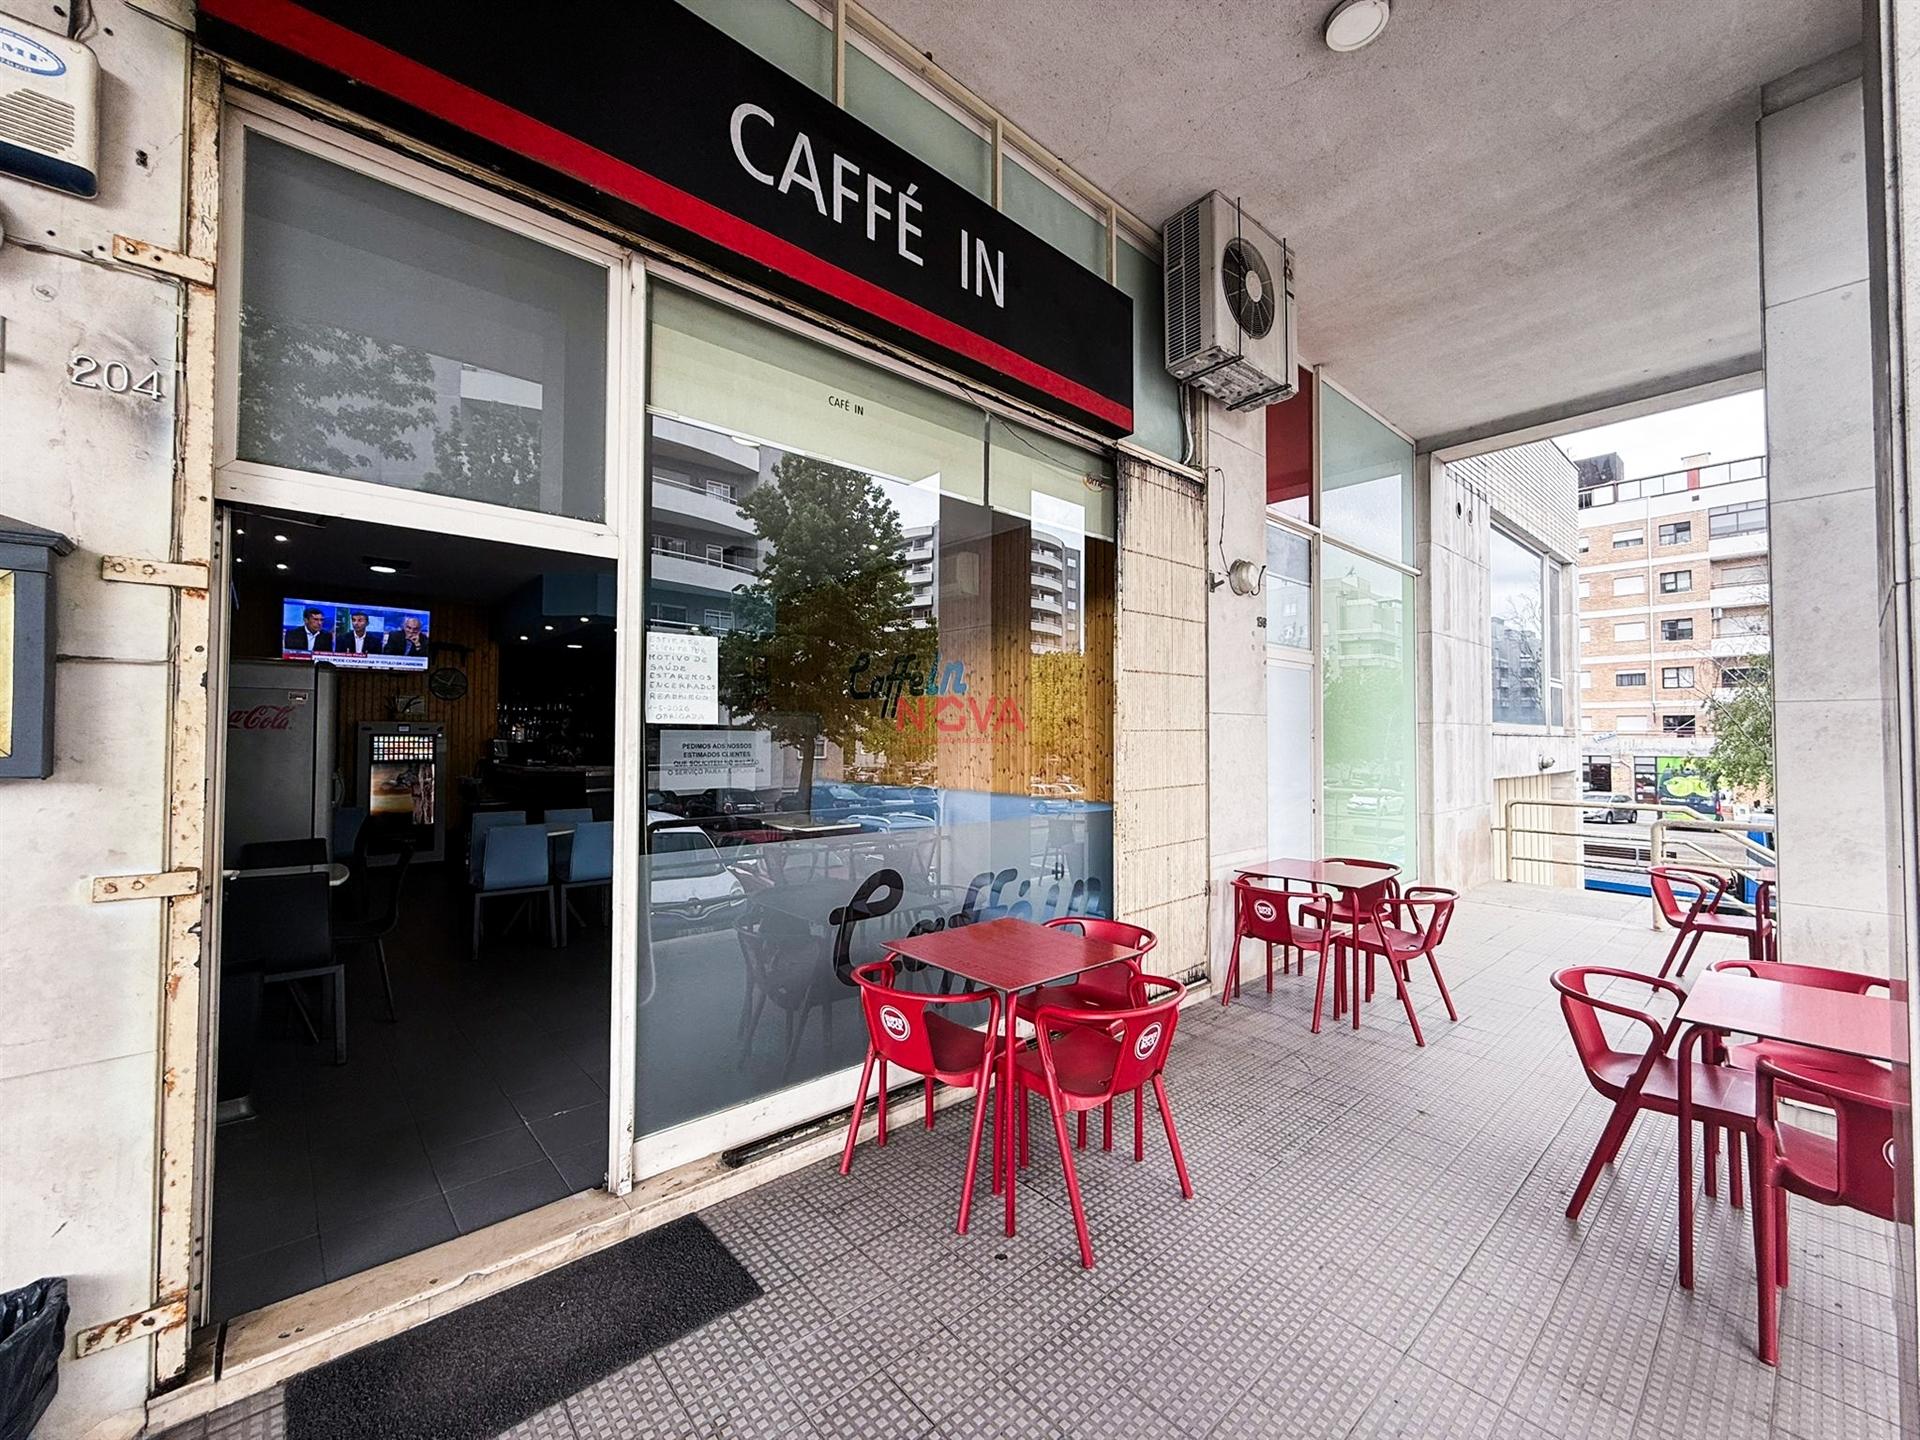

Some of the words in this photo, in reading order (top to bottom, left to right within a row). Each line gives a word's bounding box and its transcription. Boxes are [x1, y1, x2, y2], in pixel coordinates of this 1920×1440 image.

[730, 103, 924, 266] CAFFÉ
[961, 229, 1004, 308] IN
[72, 355, 162, 400] 204
[854, 404, 864, 416] IN
[648, 654, 690, 662] MOTIVO
[675, 768, 704, 776] SERVIÇO
